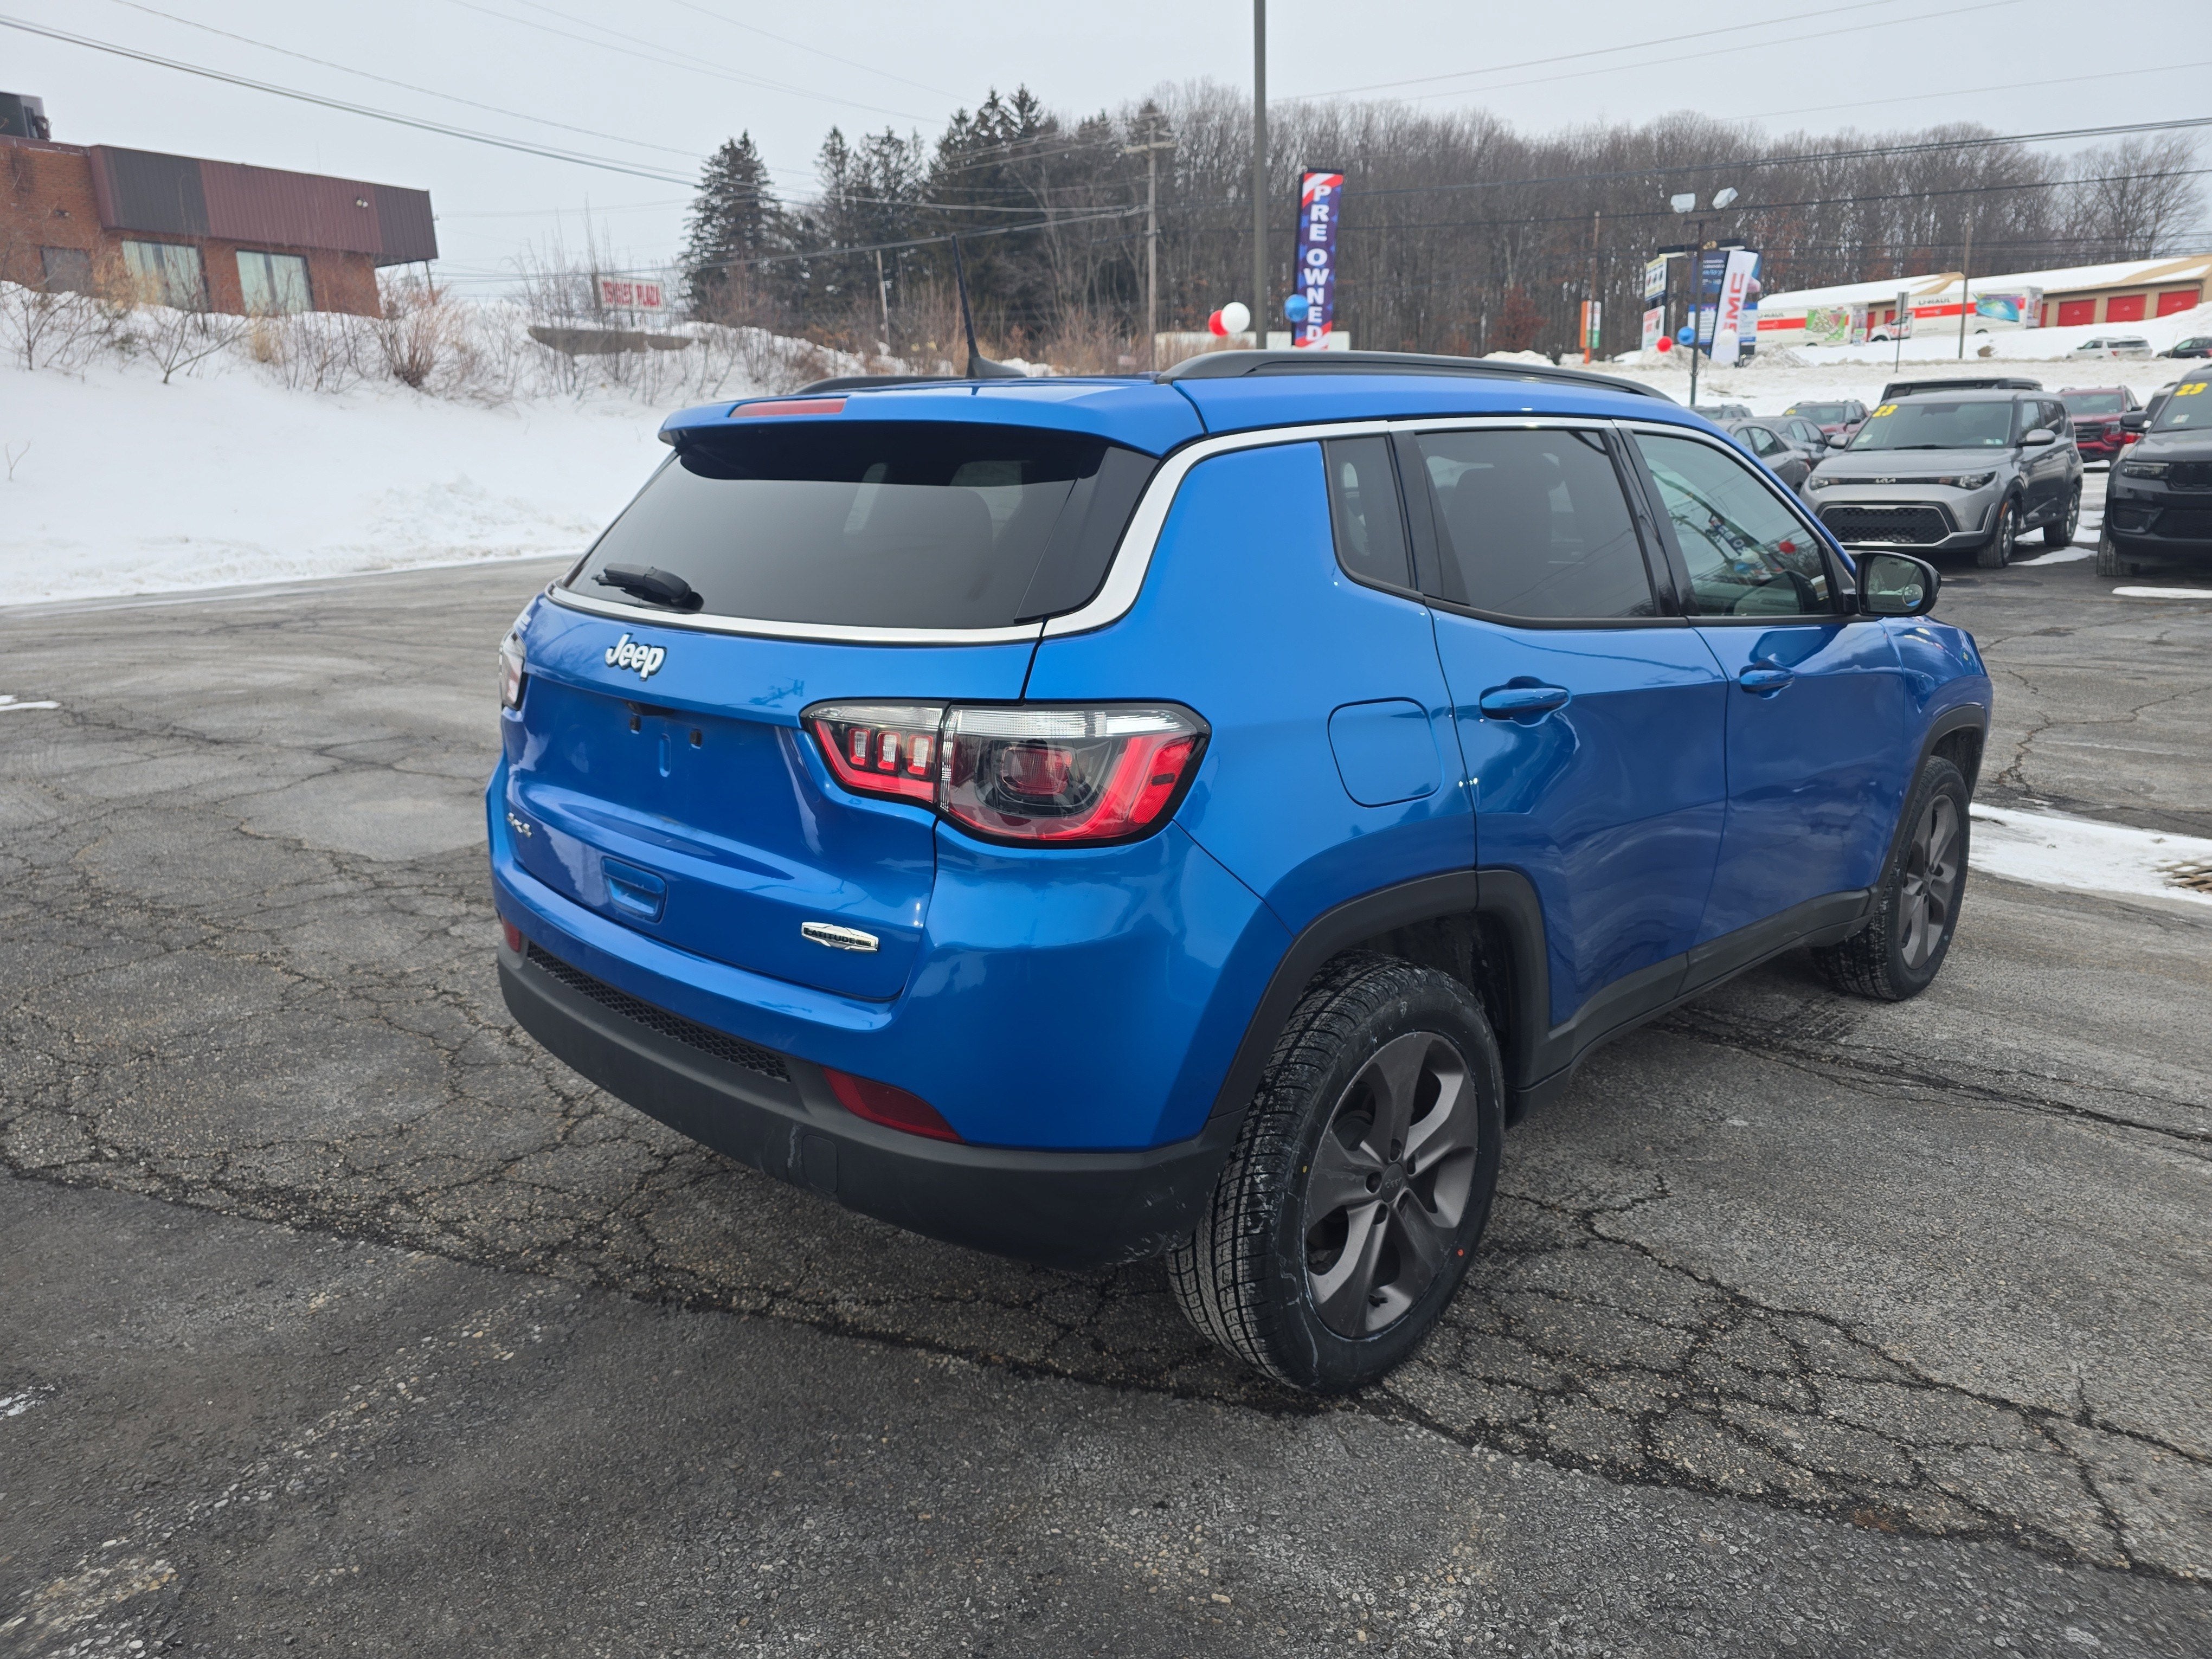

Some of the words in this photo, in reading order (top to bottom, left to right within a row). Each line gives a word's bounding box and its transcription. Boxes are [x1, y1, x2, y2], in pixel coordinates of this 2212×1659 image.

[1309, 185, 1332, 242] PRE
[1303, 247, 1330, 342] OWNED
[605, 633, 666, 681] Jeep
[803, 927, 856, 944] LATITUDE
